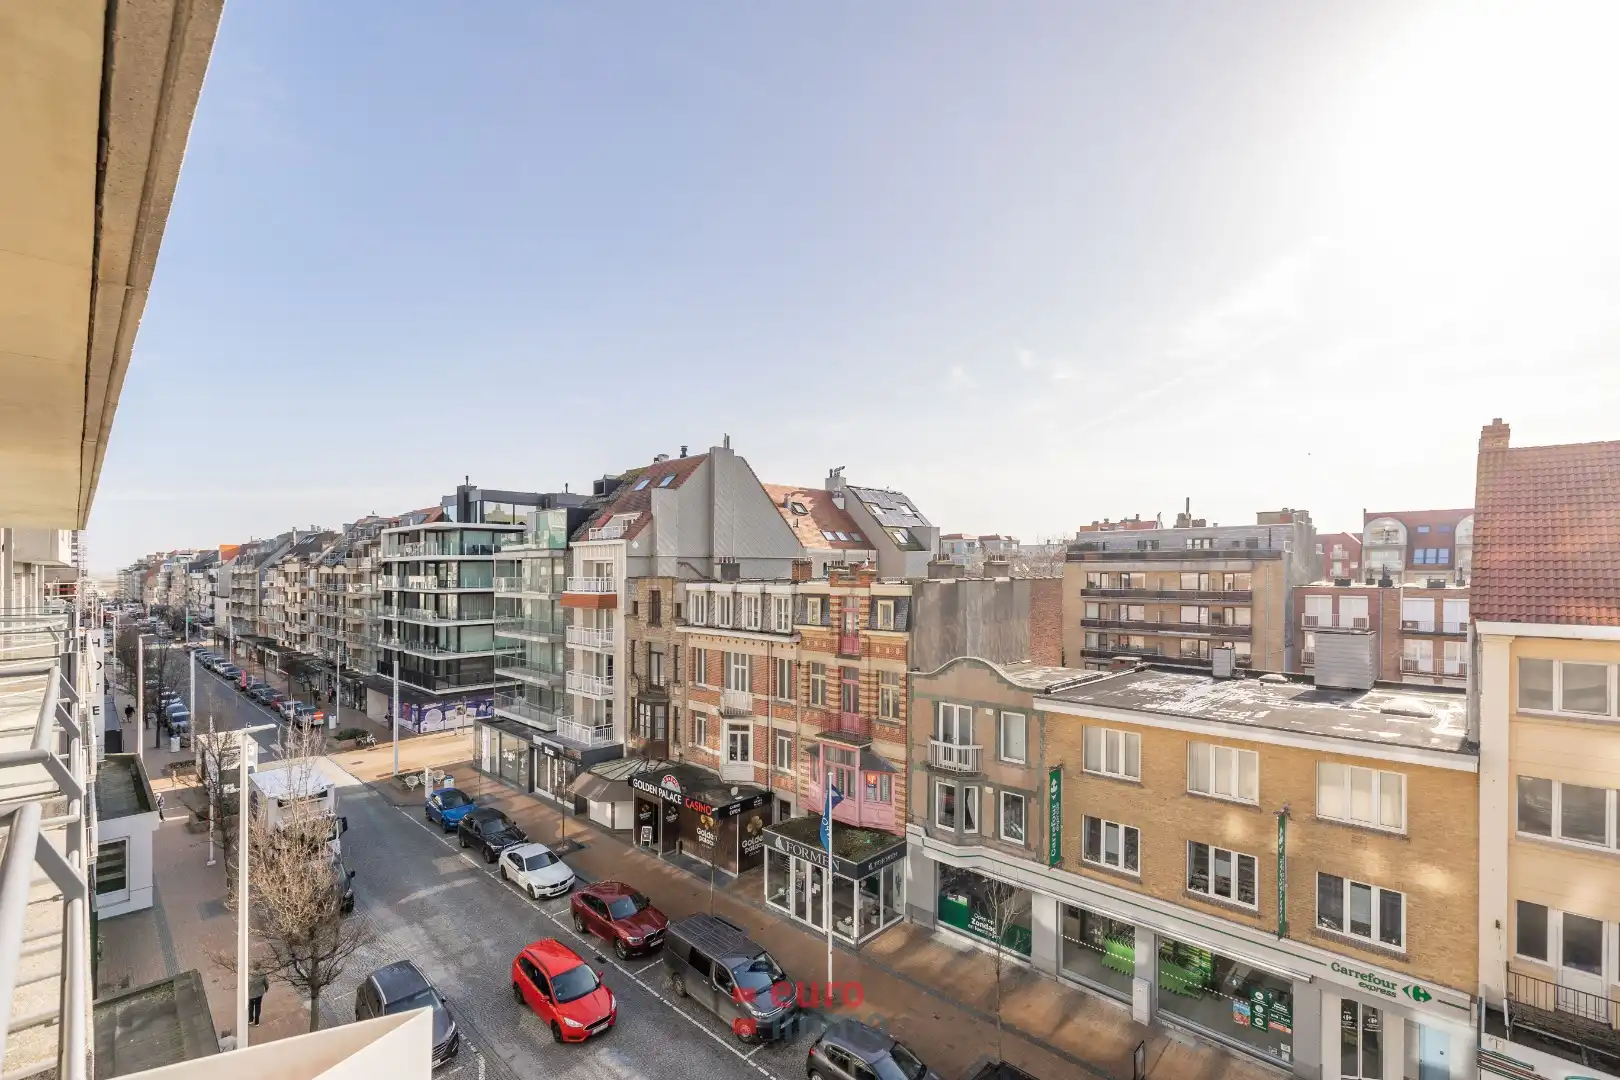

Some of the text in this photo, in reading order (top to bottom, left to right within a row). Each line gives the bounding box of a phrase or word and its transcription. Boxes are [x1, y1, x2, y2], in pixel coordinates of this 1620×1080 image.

[632, 778, 658, 796] GOLDEN
[658, 787, 682, 805] PALACE
[684, 798, 713, 817] CASINO
[741, 834, 765, 849] Golde
[785, 841, 840, 871] FORMEN
[1330, 961, 1398, 991] Carrefour
[1358, 981, 1397, 998] express
